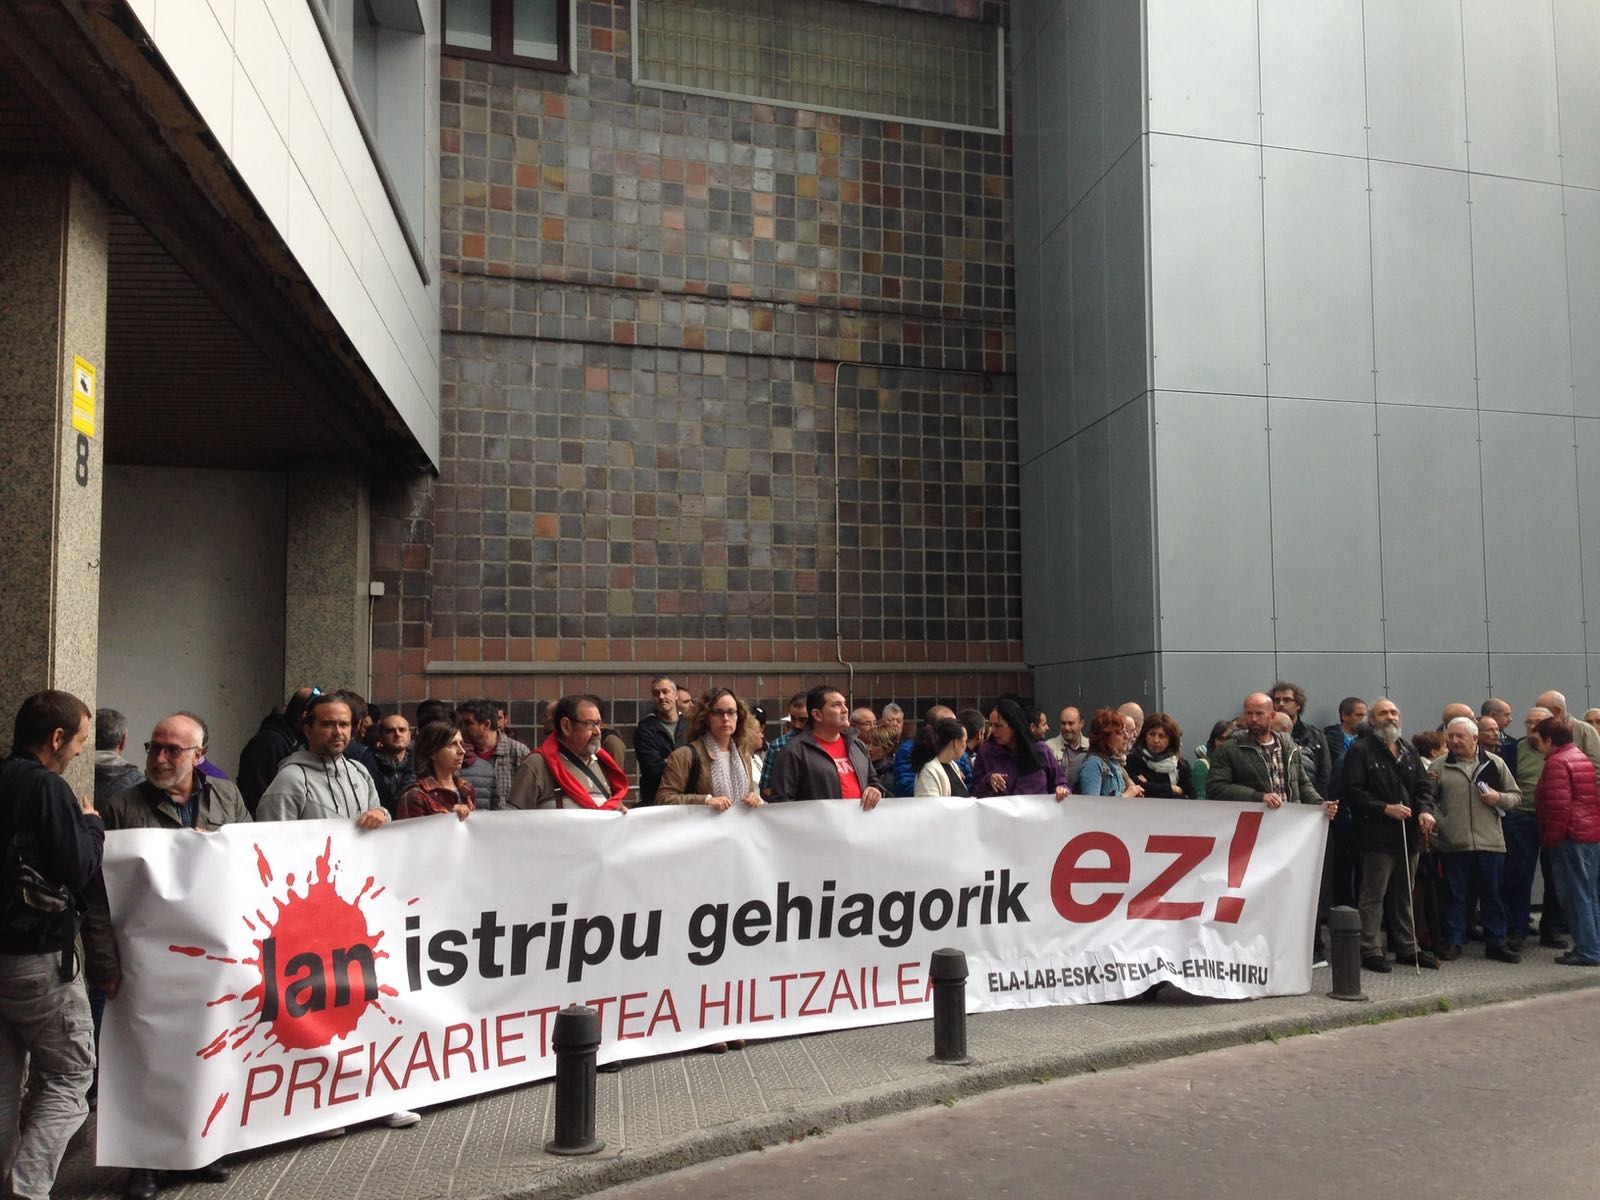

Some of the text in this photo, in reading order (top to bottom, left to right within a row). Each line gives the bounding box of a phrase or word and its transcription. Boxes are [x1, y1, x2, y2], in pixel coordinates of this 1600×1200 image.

[76, 433, 89, 488] 8
[260, 811, 1264, 1024] lan istripu gehiagorik ez!
[239, 988, 682, 1128] PREKARIETTEA
